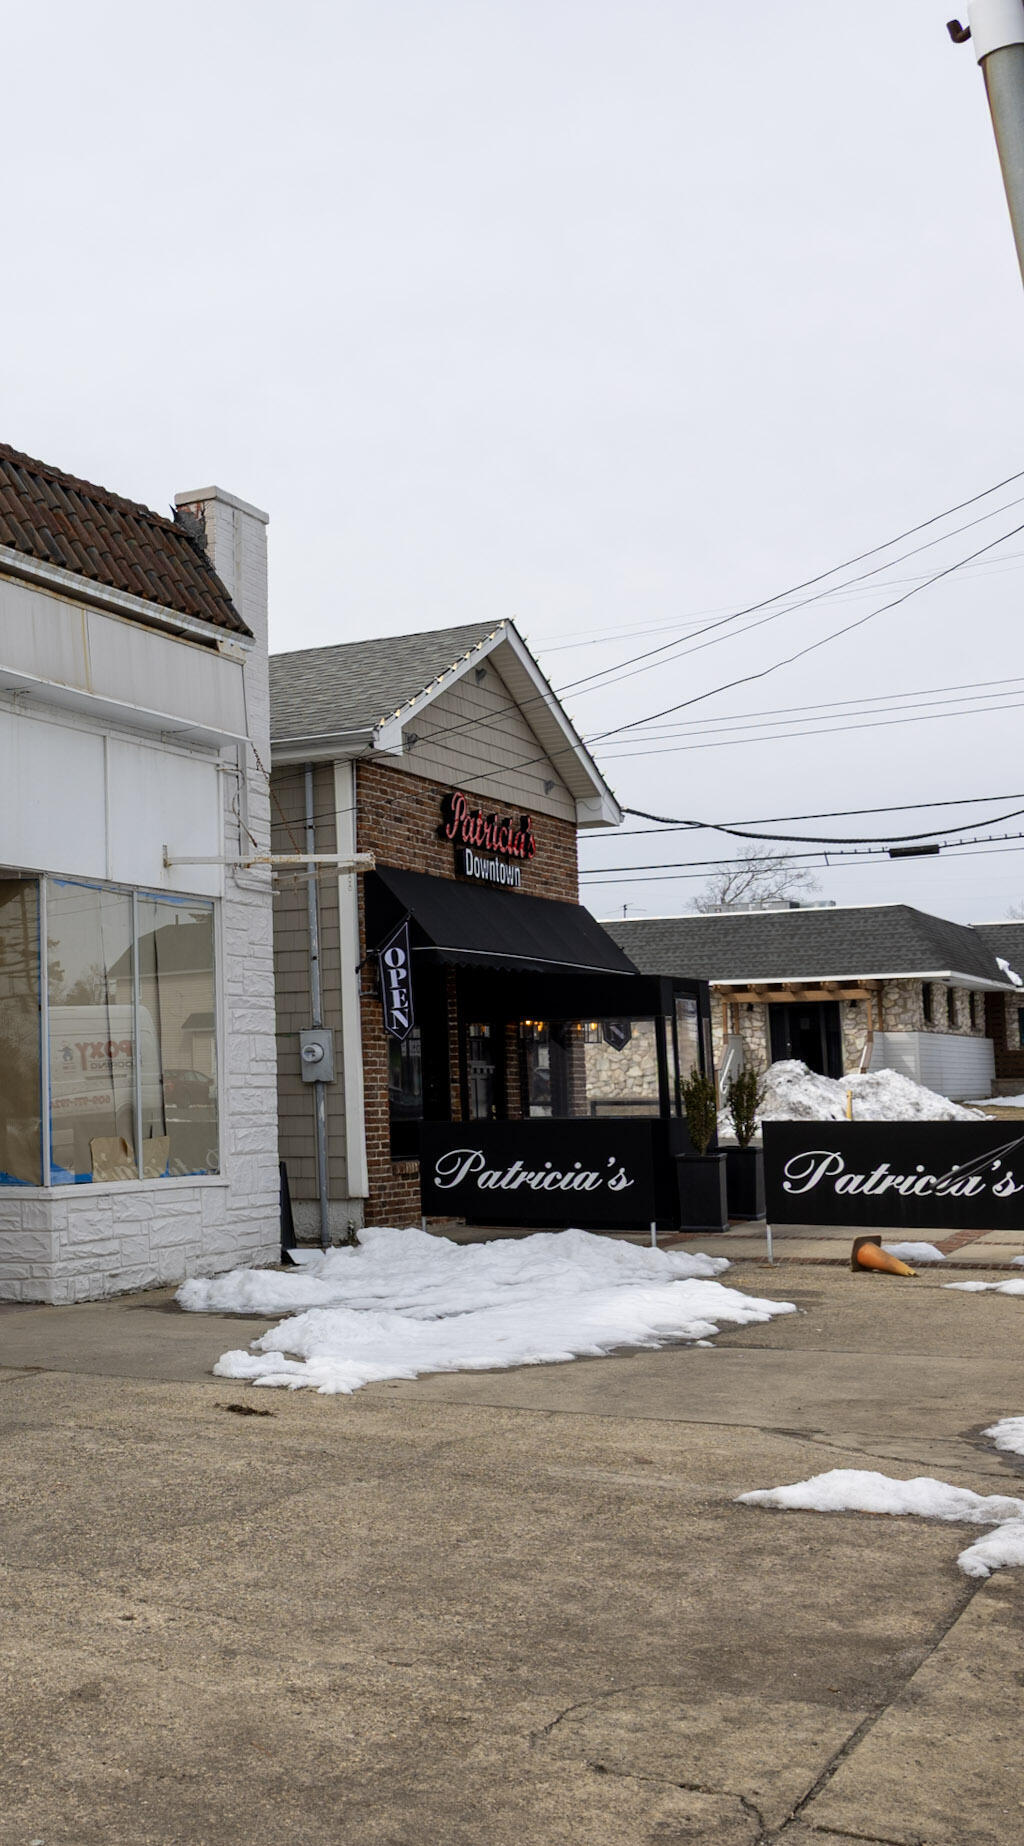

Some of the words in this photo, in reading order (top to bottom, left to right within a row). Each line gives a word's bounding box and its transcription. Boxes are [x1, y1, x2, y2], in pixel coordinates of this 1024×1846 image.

[445, 792, 536, 858] Patricia's
[465, 847, 521, 887] Downtown
[384, 947, 409, 1029] OPEN
[434, 1149, 634, 1190] Patricia's
[782, 1150, 1024, 1197] Patricia's
